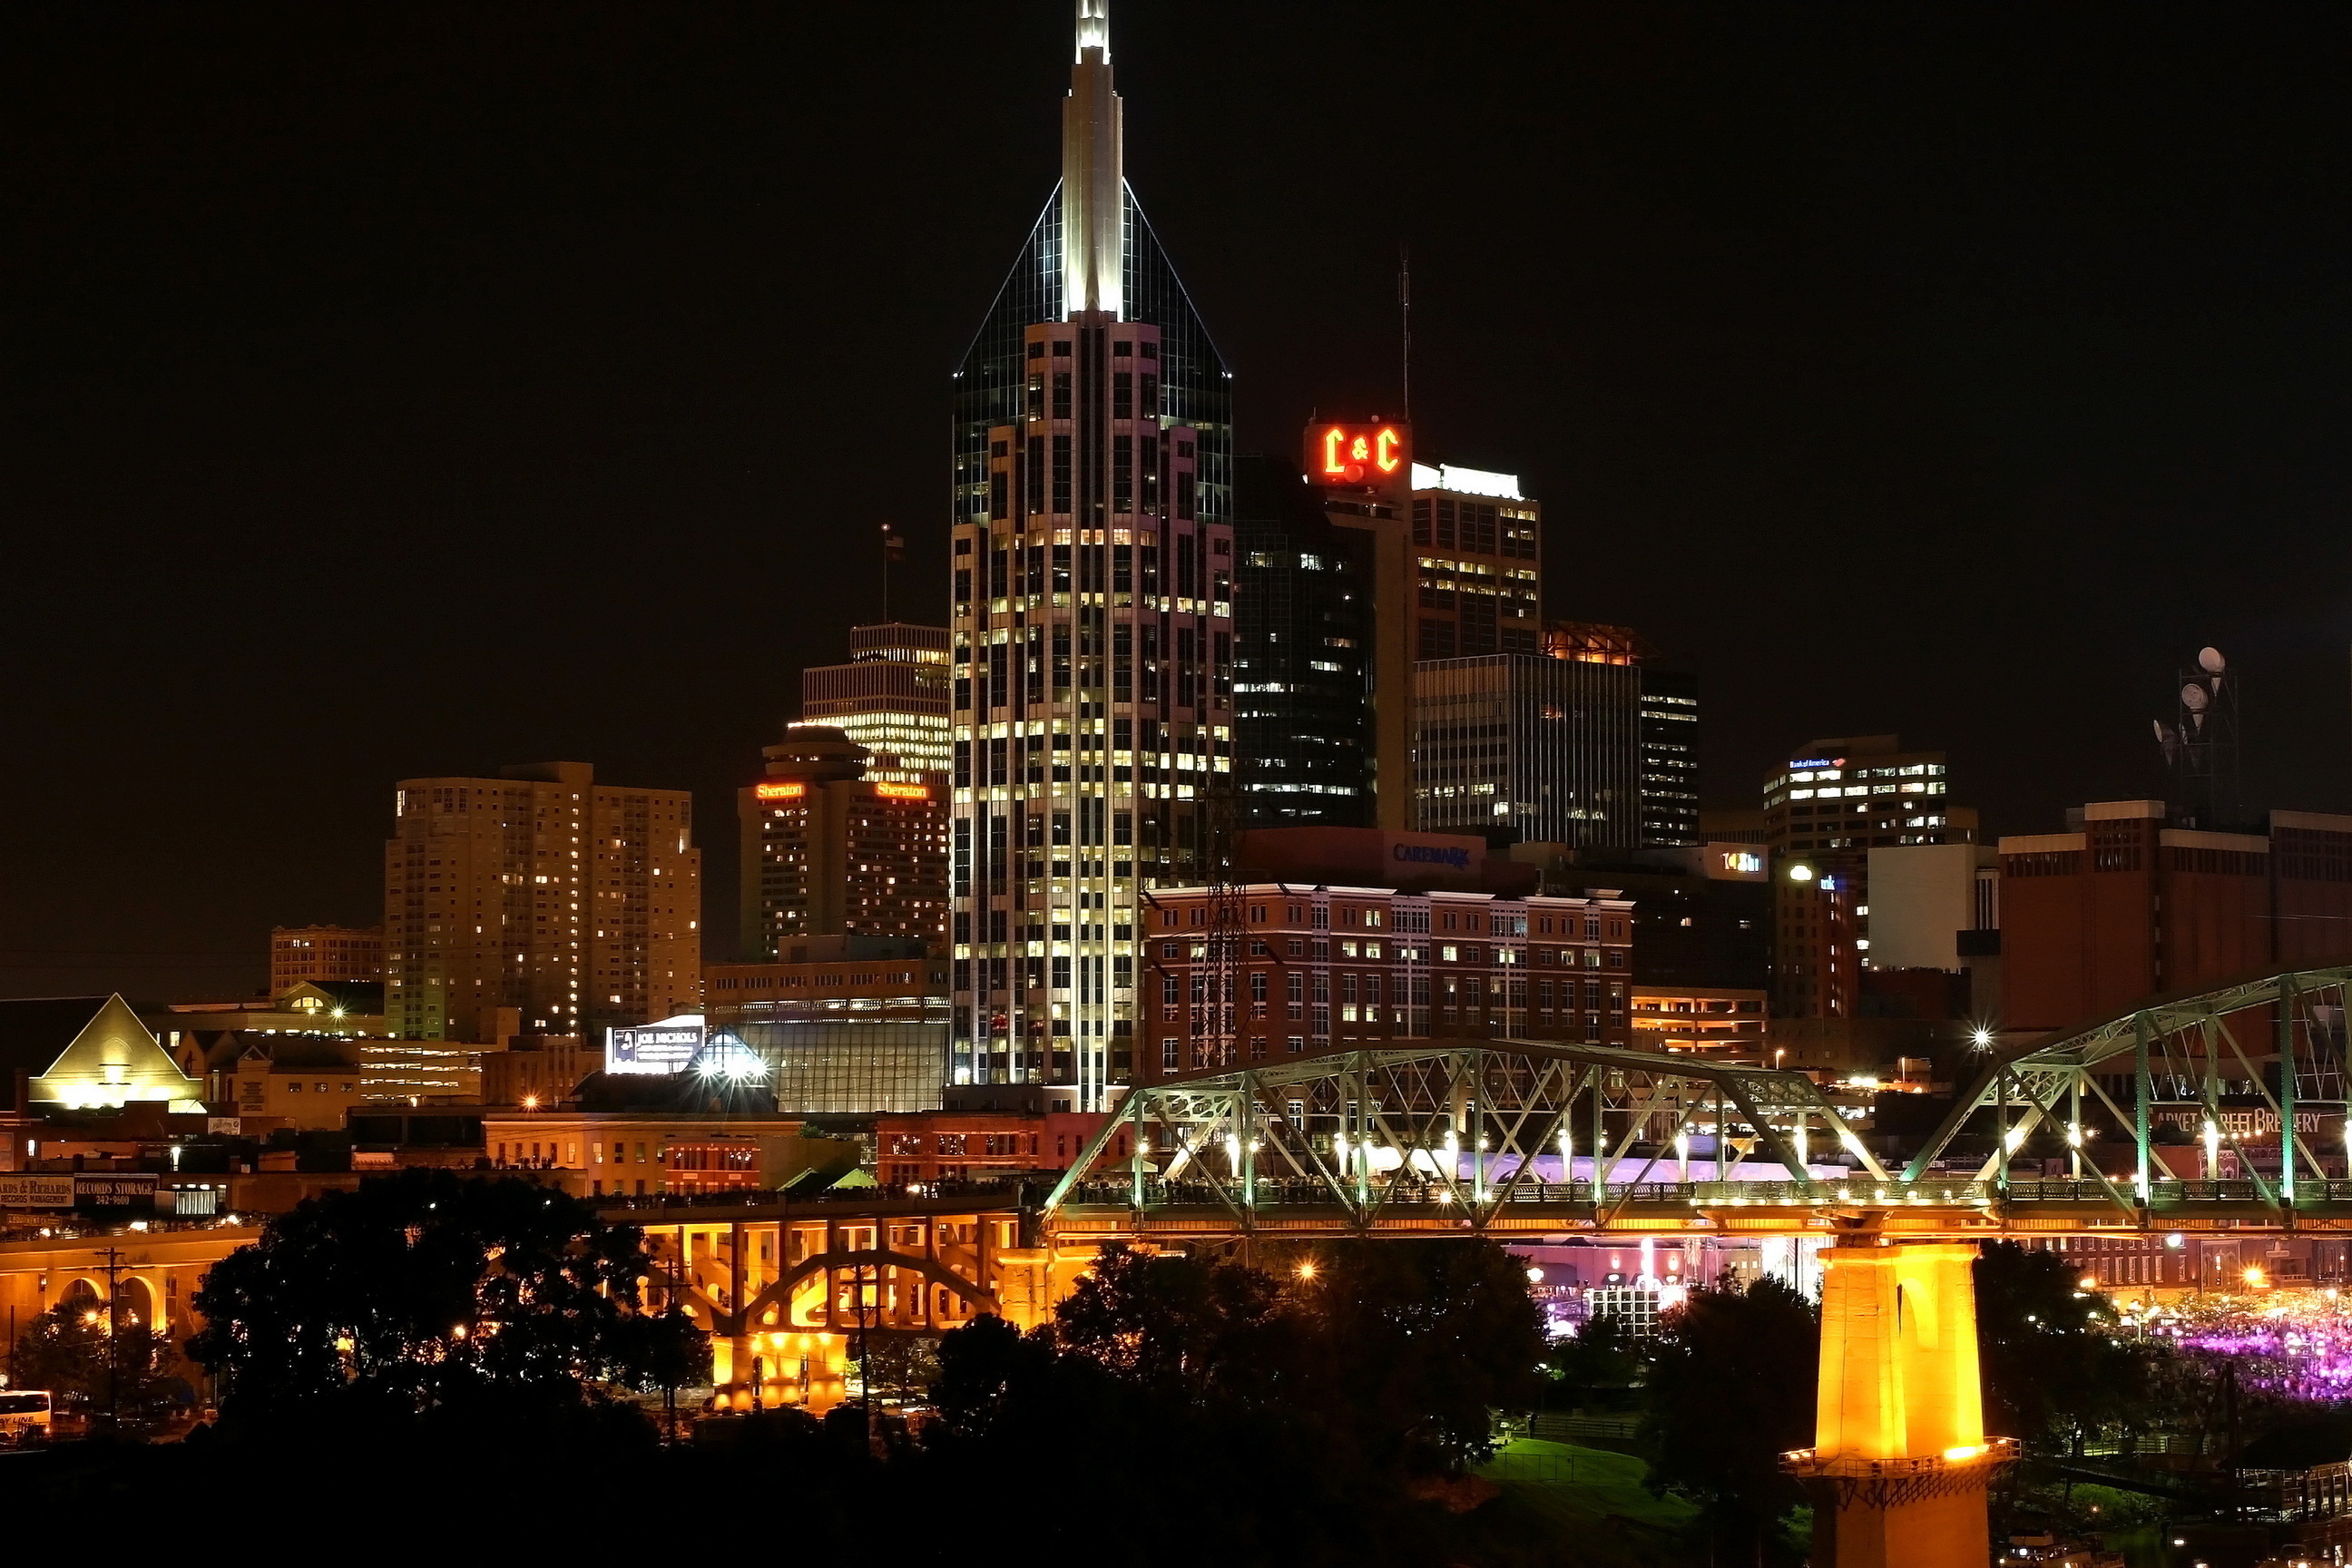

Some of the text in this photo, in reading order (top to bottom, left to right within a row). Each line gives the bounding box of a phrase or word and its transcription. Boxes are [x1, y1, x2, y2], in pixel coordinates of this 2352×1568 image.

[758, 785, 802, 799] Sheraton
[877, 783, 926, 798] Sheraton
[2255, 1107, 2321, 1132] BREERY
[20, 1180, 27, 1194] &
[29, 1181, 72, 1195] RICHARDS
[75, 1181, 153, 1195] RECORDS STORAGE
[1, 1194, 67, 1204] RECORDS MANAGEMENT
